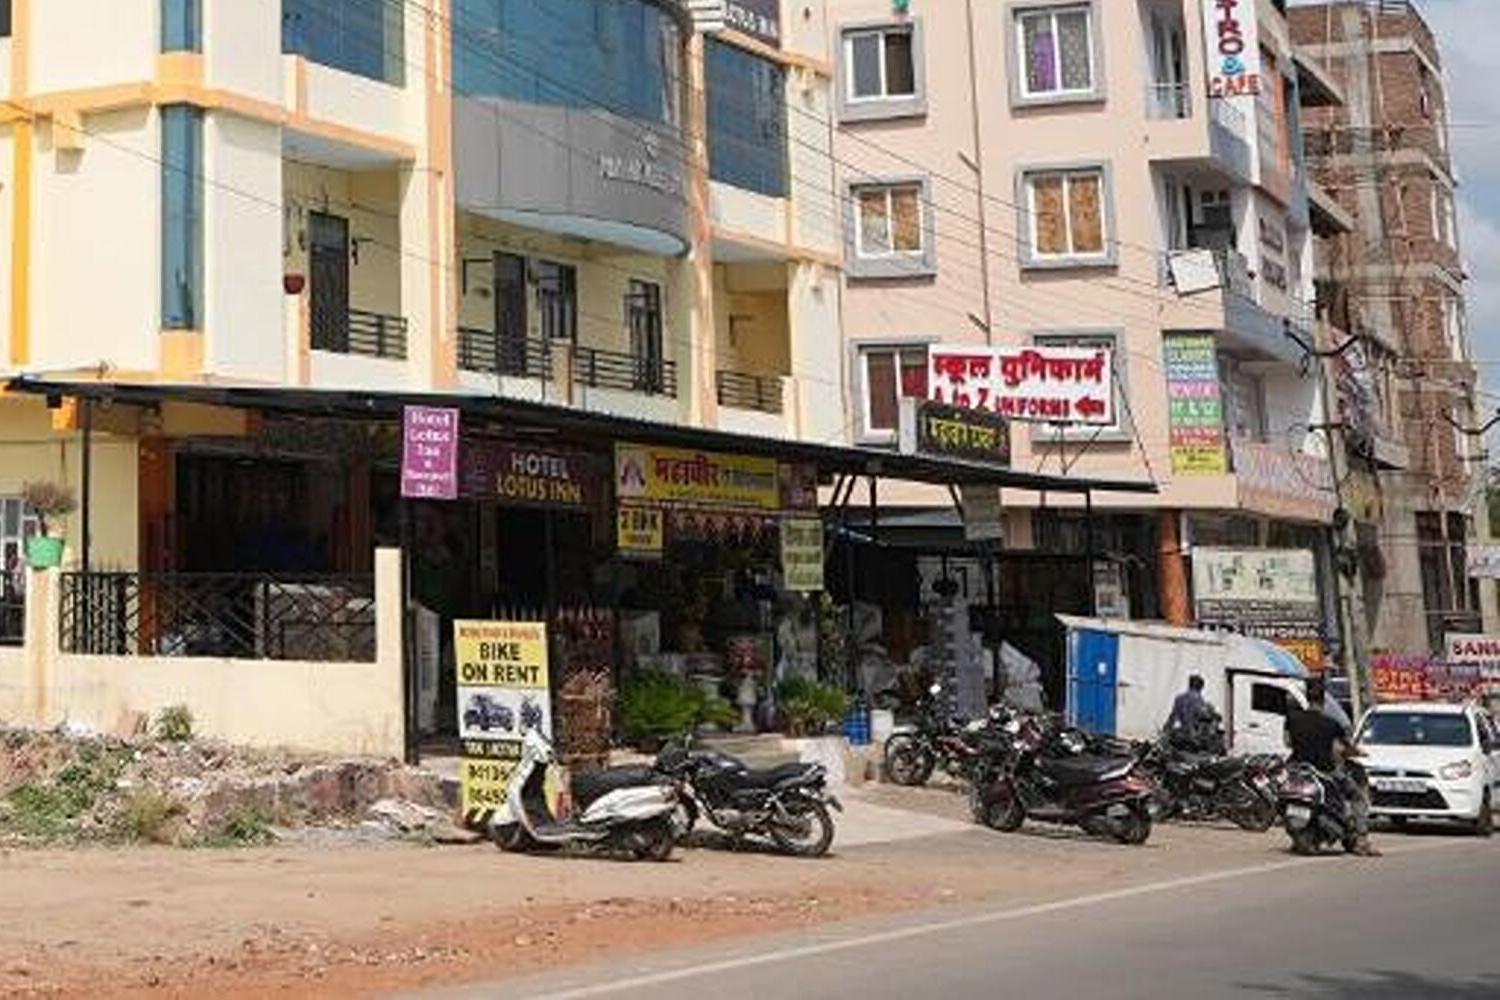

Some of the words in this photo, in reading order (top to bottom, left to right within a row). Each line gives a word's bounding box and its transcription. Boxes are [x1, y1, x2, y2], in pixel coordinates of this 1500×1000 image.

[1211, 74, 1259, 97] CAFE
[932, 354, 993, 384] स्कूल
[512, 452, 568, 479] HOTEL
[496, 475, 546, 500] LOTUS
[550, 481, 581, 504] INN
[480, 642, 521, 661] BIKE
[462, 662, 487, 681] ON
[494, 664, 540, 684] RENT
